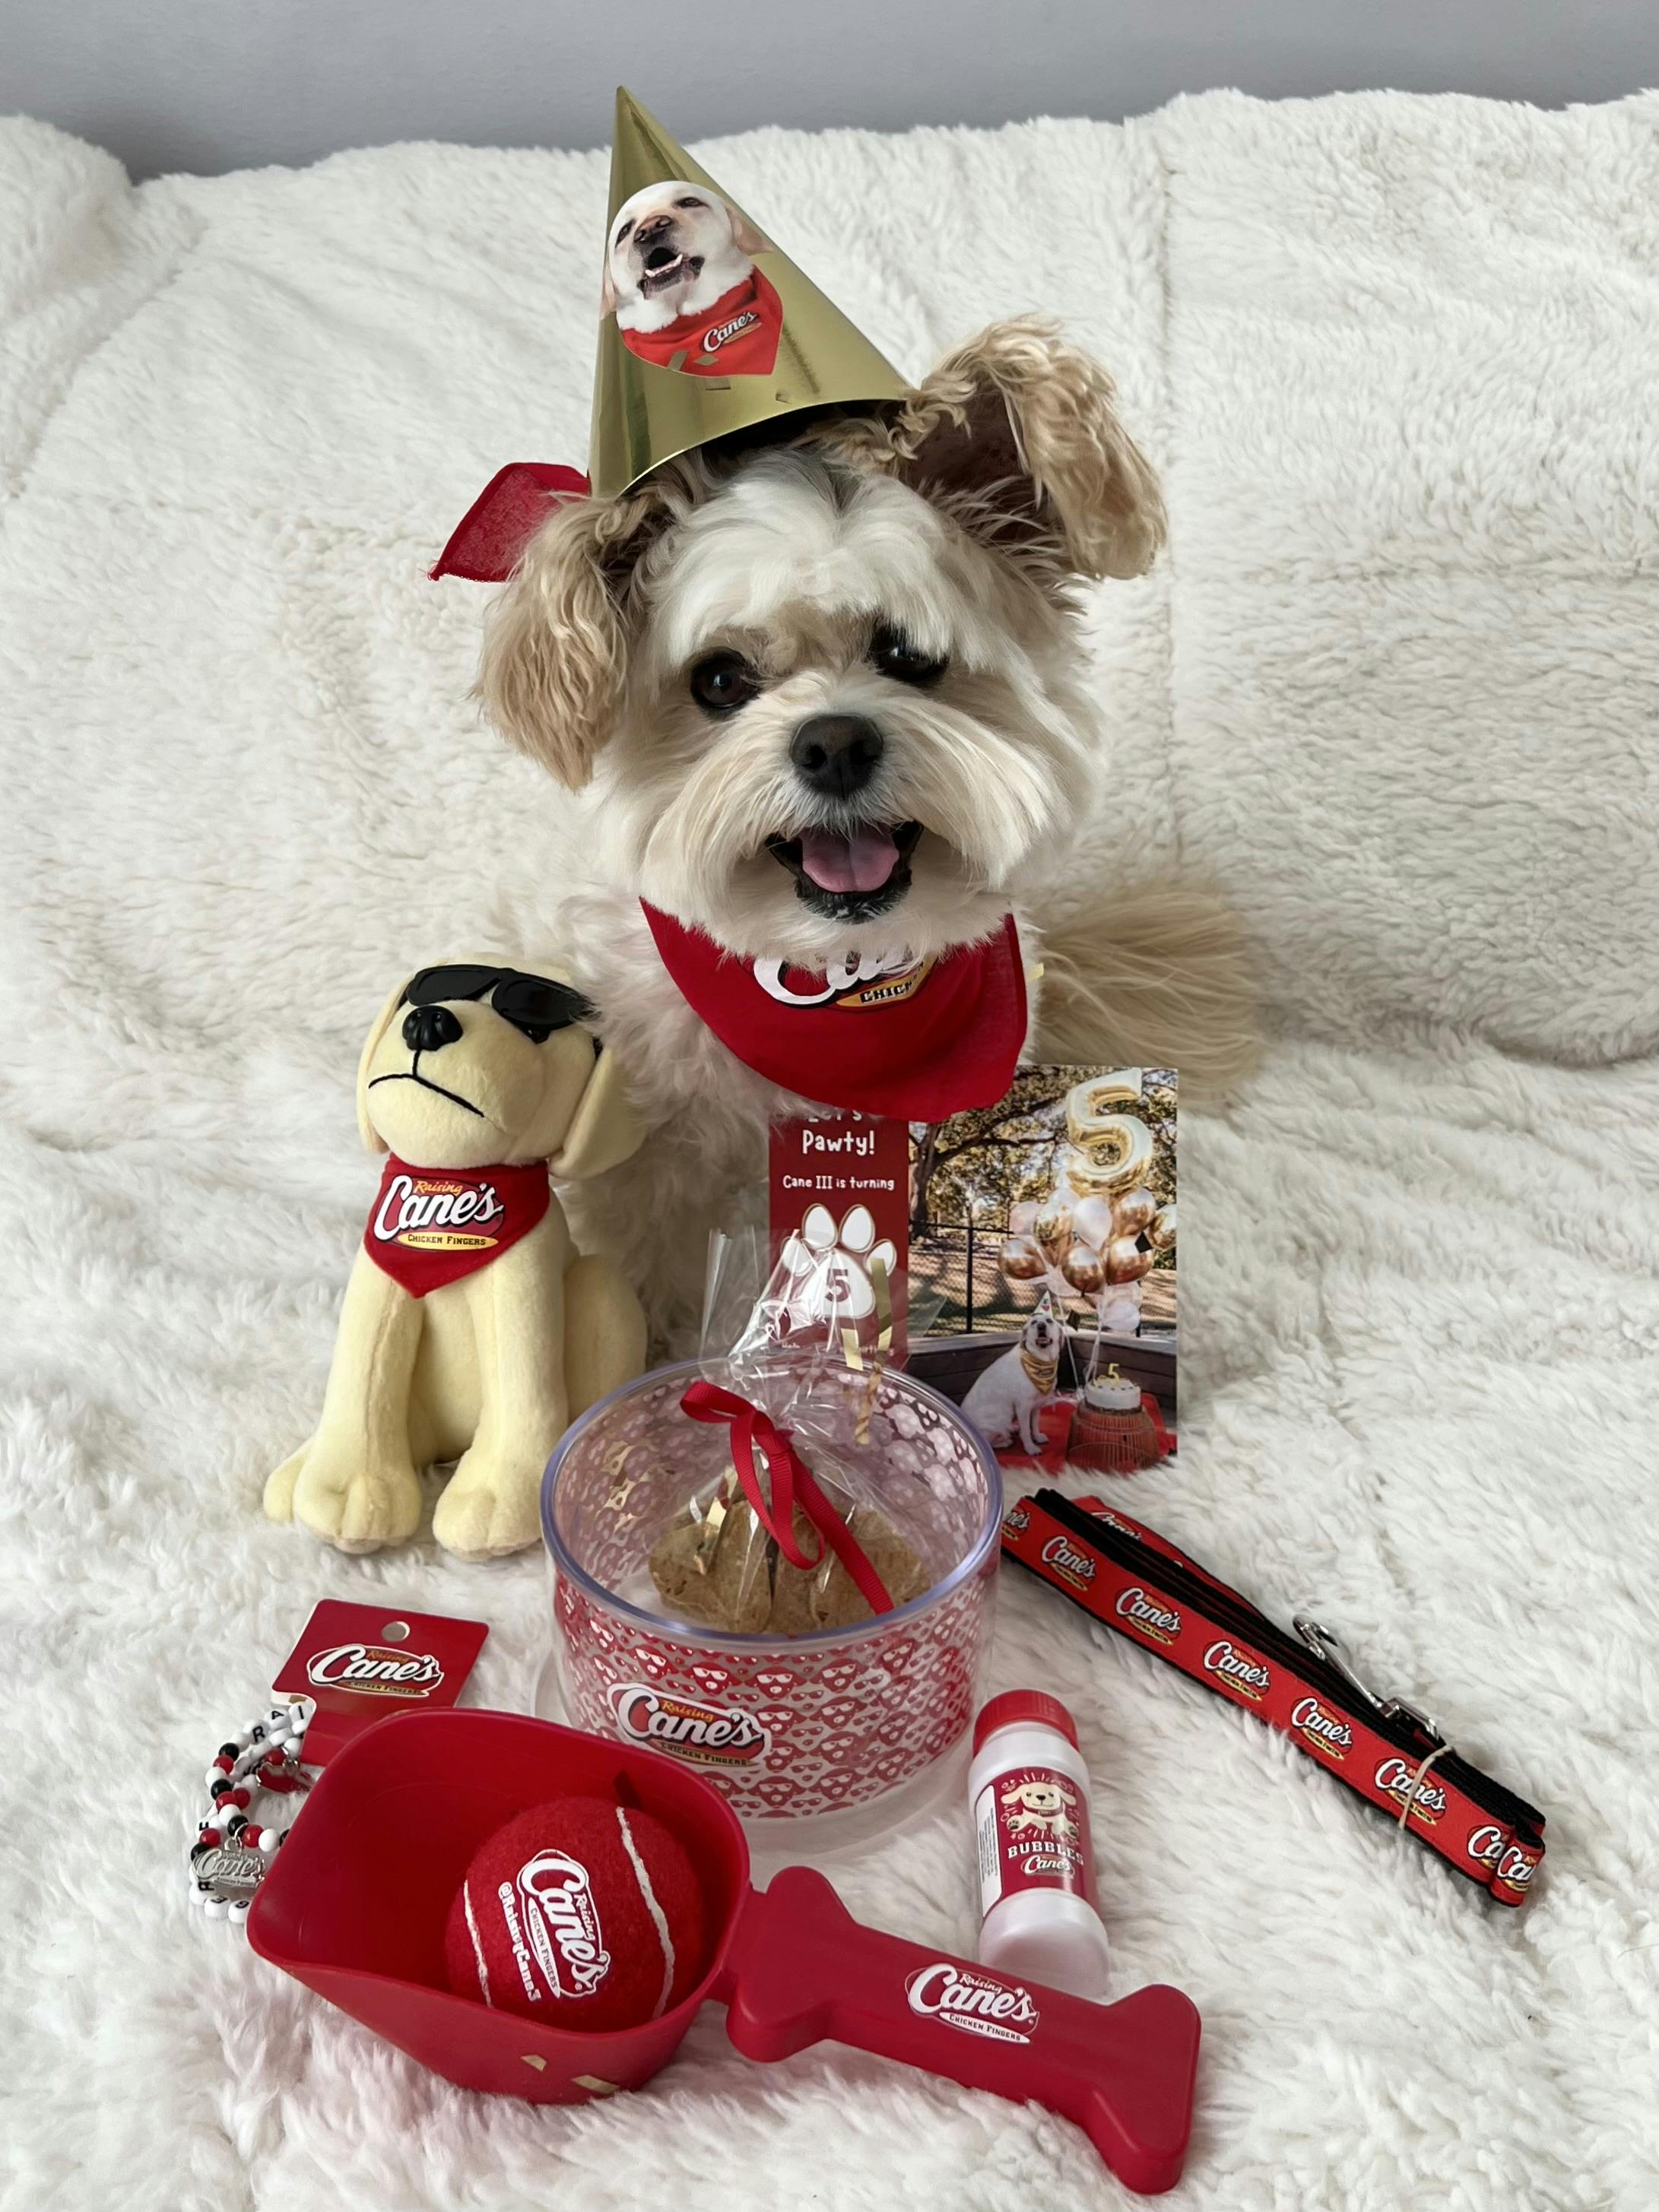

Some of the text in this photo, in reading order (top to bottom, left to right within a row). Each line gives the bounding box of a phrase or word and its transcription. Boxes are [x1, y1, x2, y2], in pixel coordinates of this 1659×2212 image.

[703, 311, 758, 353] Cane's
[802, 1130, 874, 1156] Pawty!
[413, 1180, 464, 1196] Raising
[782, 1175, 895, 1191] Cane III is turning
[373, 1174, 504, 1241] Cane's
[408, 1234, 487, 1246] CHICKEN FINGERS
[825, 1268, 851, 1303] 5
[1042, 1535, 1095, 1577] Cane's
[1116, 1587, 1180, 1631] Cane's
[311, 1644, 441, 1683] Cane's
[1204, 1641, 1269, 1687] Cane's
[618, 1687, 763, 1747] Cane's
[661, 1700, 714, 1723] Raising
[1292, 1697, 1352, 1745] Cane's
[1007, 1840, 1083, 1866] BUBBLES
[521, 1857, 608, 1989] Cane's
[573, 1893, 596, 1941] Raising
[530, 1907, 559, 1989] CHICKEN FINGERS
[908, 1963, 1037, 2022] Cane's
[960, 1973, 1003, 1995] Raising
[949, 2014, 1021, 2042] CHICKEN FINGERS
